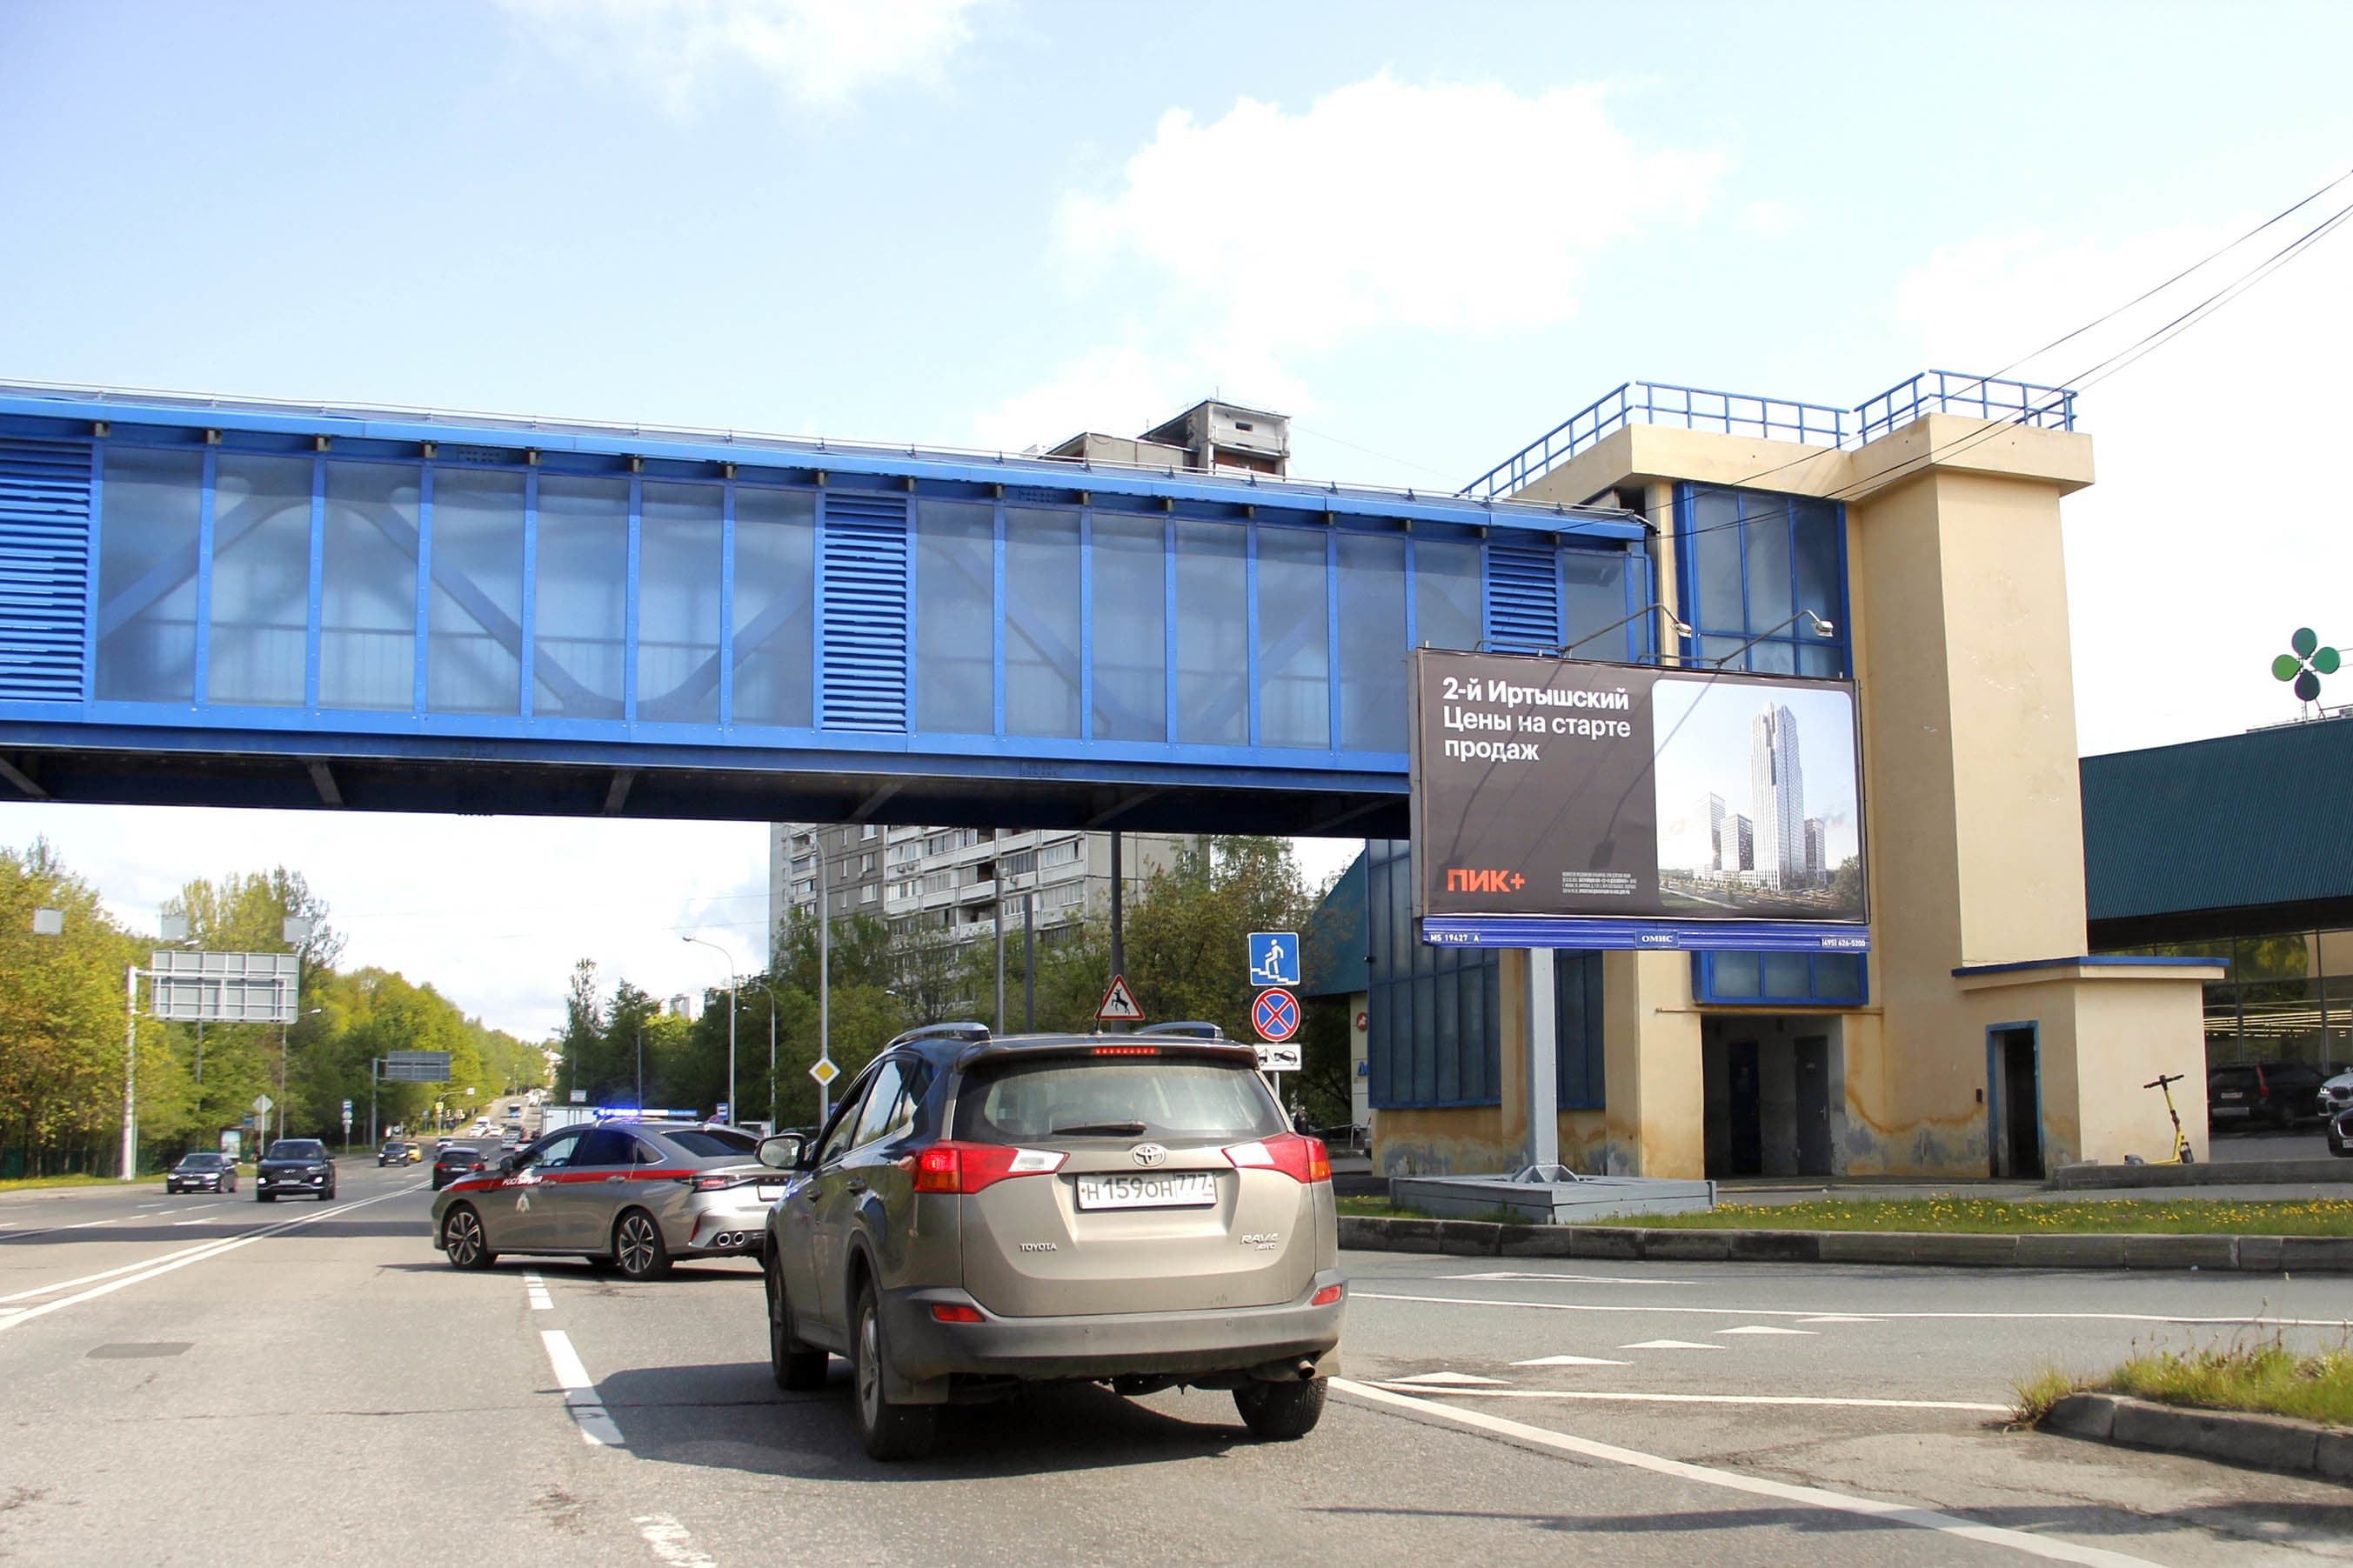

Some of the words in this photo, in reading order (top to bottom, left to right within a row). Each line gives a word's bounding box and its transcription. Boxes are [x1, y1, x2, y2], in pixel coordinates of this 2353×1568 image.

[1442, 677, 1481, 701] 2-й
[1487, 679, 1629, 710] Иртышский
[1443, 705, 1511, 731] Цены
[1518, 715, 1546, 733] на
[1552, 717, 1631, 740] старте
[1444, 739, 1540, 762] продаж
[1447, 869, 1526, 892] ПИК+
[1430, 933, 1442, 942] MS
[1445, 933, 1468, 943] 19427
[1175, 1174, 1207, 1191] 777
[1019, 1243, 1058, 1252] TOYOTA
[1240, 1232, 1279, 1244] RAV4
